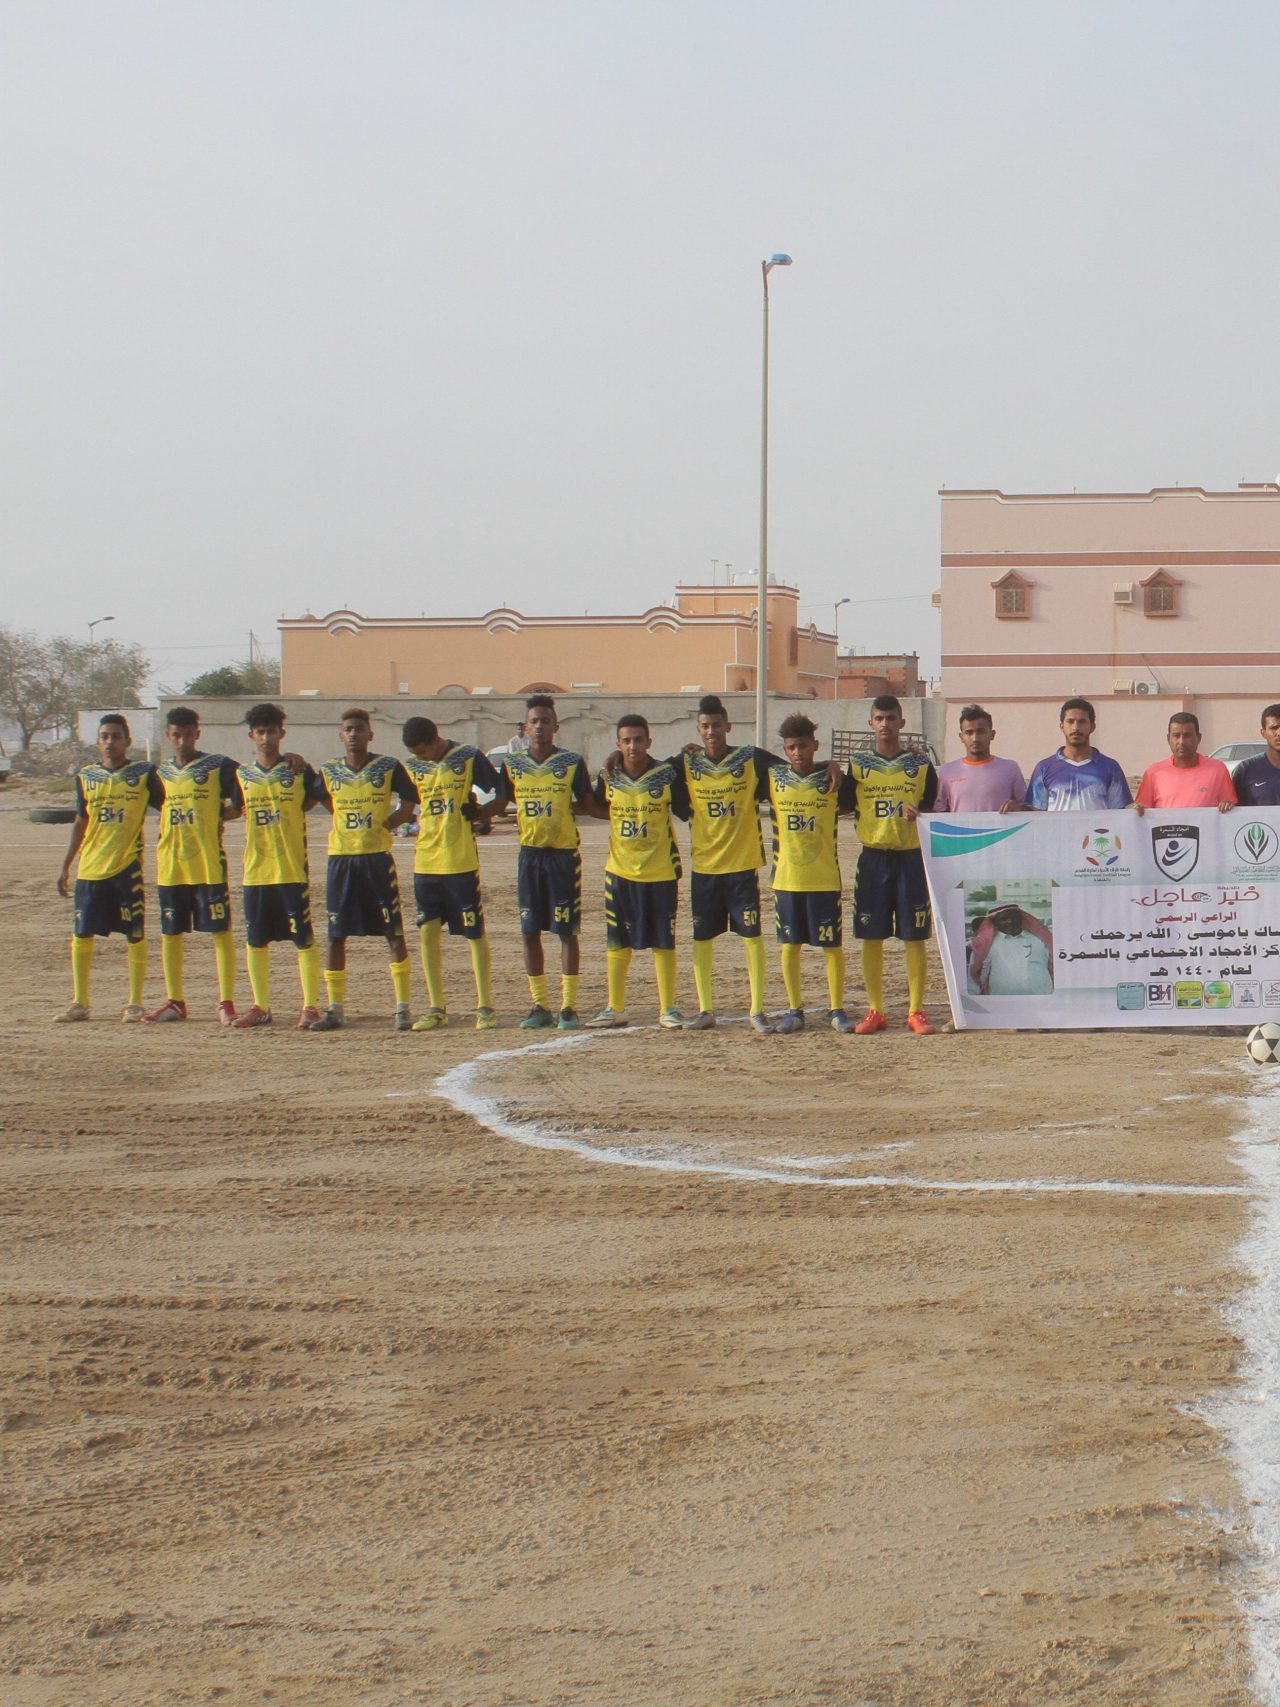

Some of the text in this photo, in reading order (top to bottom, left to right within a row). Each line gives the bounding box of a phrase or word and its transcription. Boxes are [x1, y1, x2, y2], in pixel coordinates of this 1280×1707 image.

[1139, 886, 1260, 907] خبر عاجل
[210, 902, 226, 920] 19
[462, 912, 476, 926] 13
[554, 906, 570, 922] 54
[744, 910, 758, 926] 50
[1155, 912, 1236, 924] الراعي الرسمي
[290, 918, 297, 934] 2
[915, 912, 926, 928] 17
[818, 926, 834, 942] 24
[1058, 948, 1120, 960] بالسمرة
[1126, 946, 1203, 963] الاجتماعي
[1220, 964, 1252, 976] لعام
